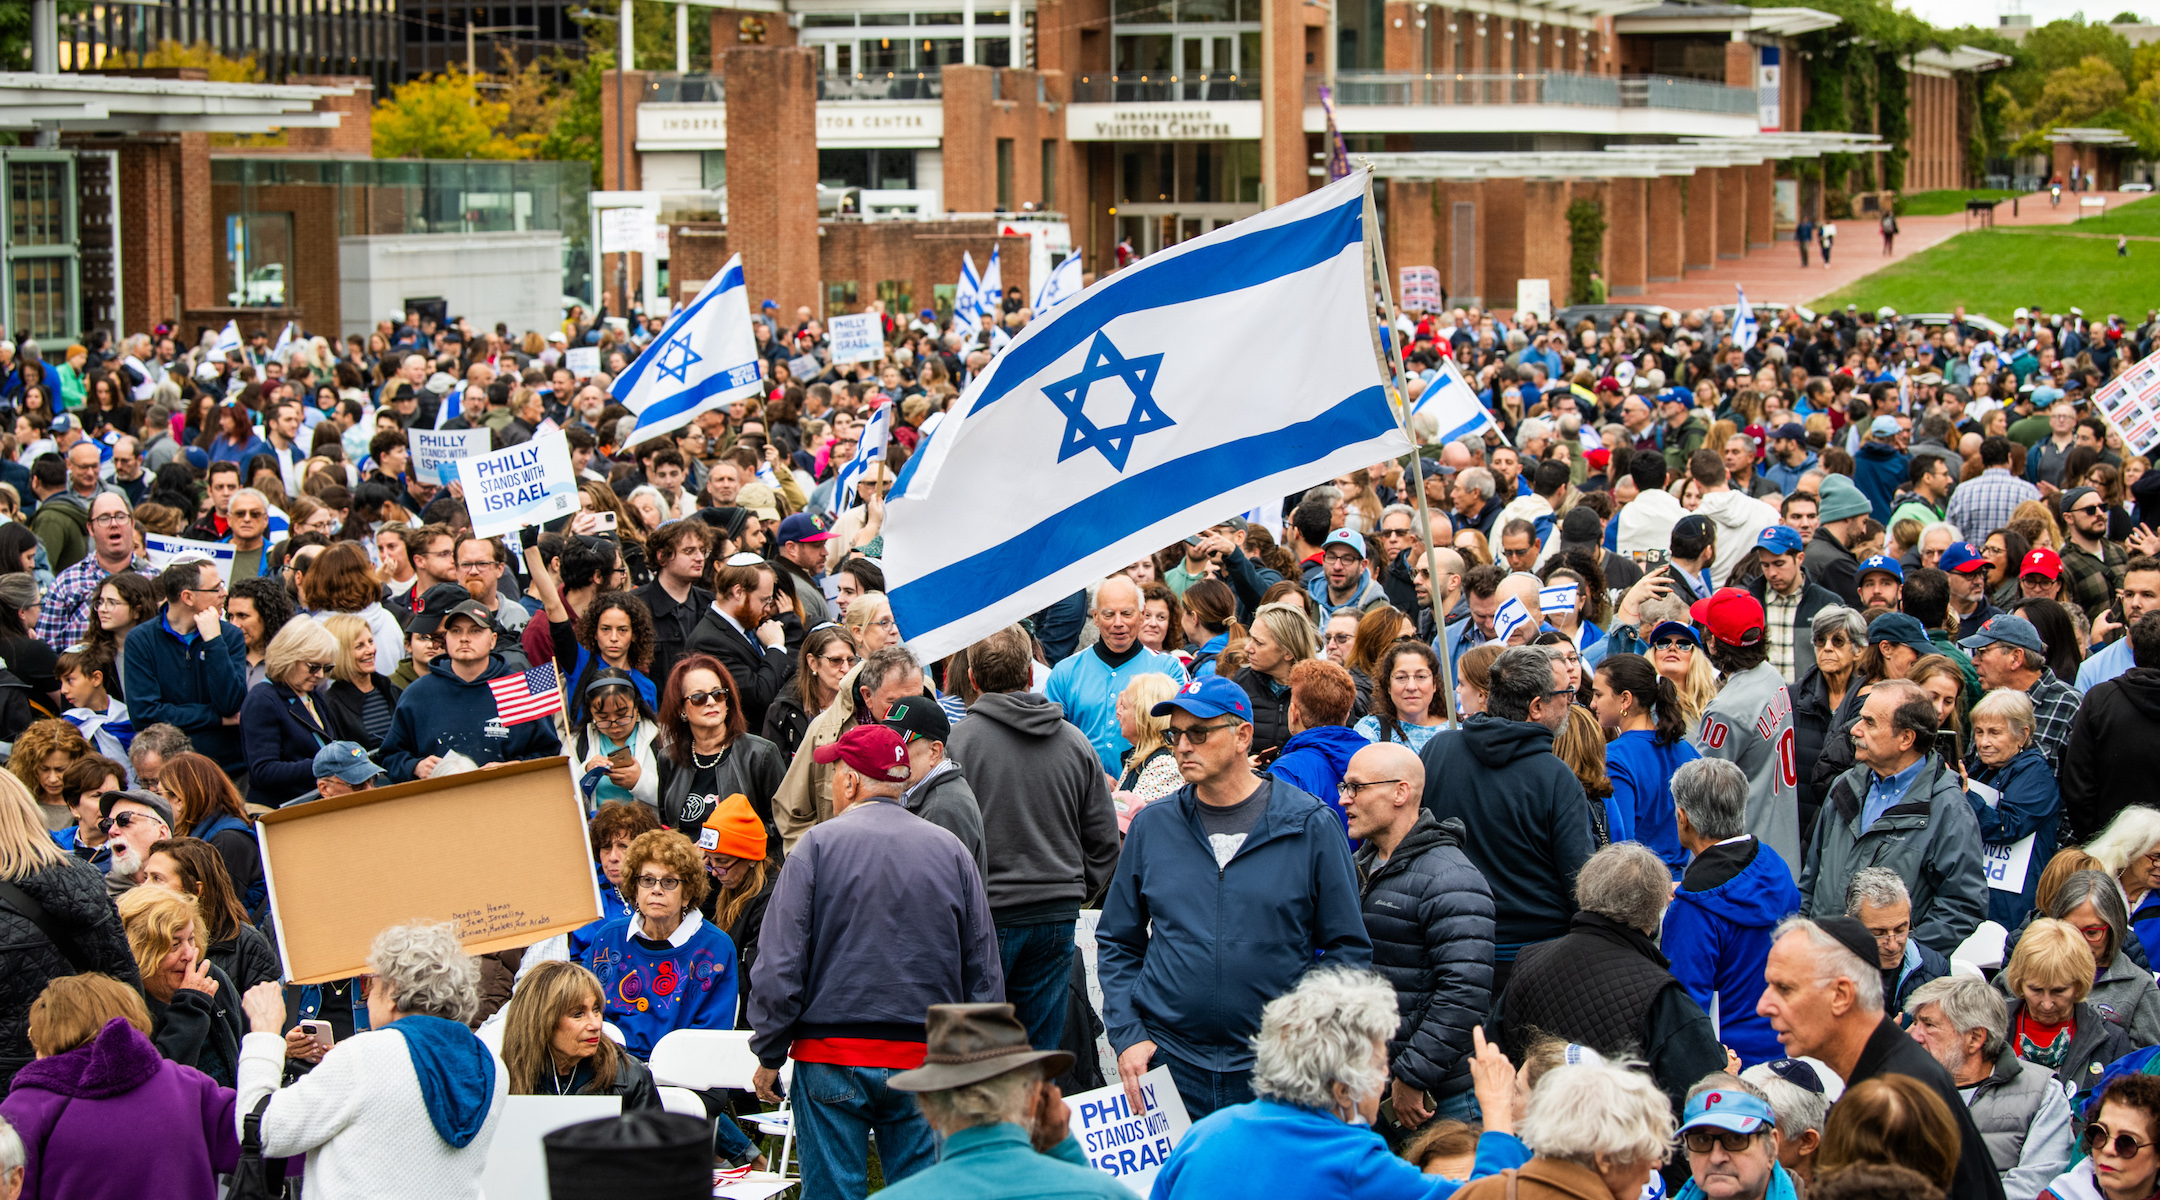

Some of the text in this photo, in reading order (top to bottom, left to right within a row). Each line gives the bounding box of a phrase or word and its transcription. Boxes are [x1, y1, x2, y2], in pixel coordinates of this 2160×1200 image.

[862, 115, 922, 128] CENTER
[420, 434, 466, 447] PHILLY
[420, 447, 468, 459] STANDS WITH
[421, 458, 456, 470] ISR
[476, 446, 539, 478] PHILLY
[480, 464, 545, 494] STANDS WITH
[484, 481, 551, 512] ISRAEL
[1763, 528, 1776, 539] C
[2032, 552, 2044, 564] P
[1702, 716, 1729, 749] 10
[487, 903, 511, 914] Hamas
[1080, 1083, 1159, 1129] PHILY
[1704, 1092, 1722, 1111] P
[1086, 1110, 1170, 1153] STANDS WITH
